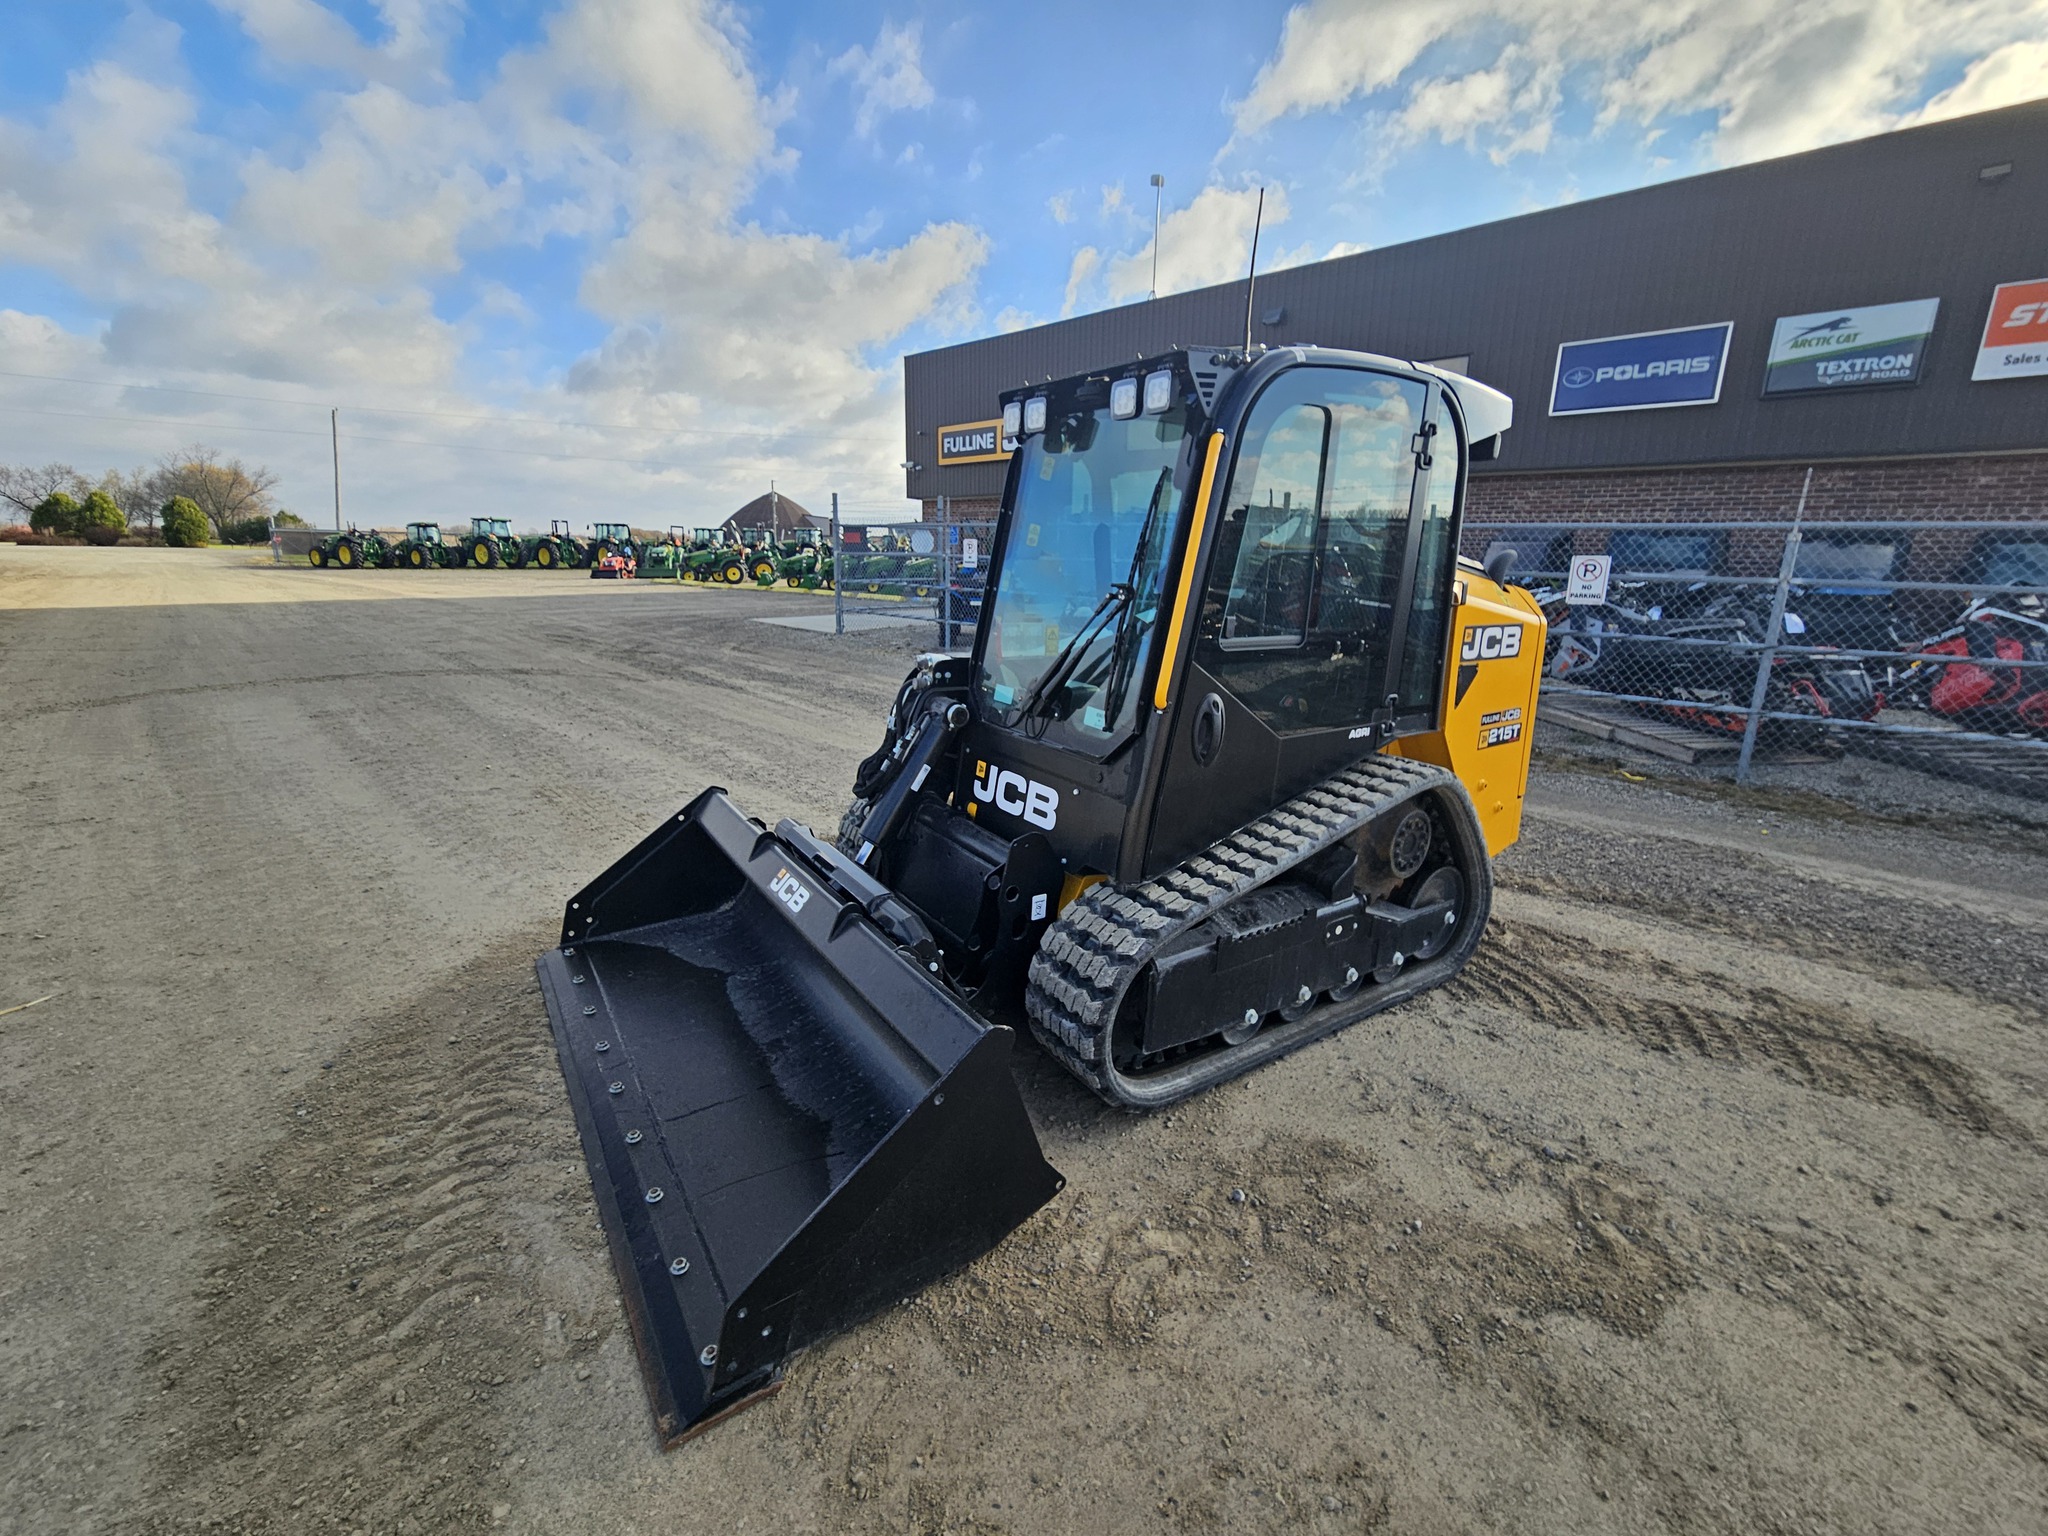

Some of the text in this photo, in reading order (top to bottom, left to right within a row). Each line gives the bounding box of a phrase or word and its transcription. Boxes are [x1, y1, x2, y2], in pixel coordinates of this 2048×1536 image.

[1790, 332, 1862, 350] ARCTIC CAT
[1595, 355, 1711, 383] POLARIS
[1815, 353, 1914, 376] TEXTRON
[2003, 353, 2041, 366] Sales
[1843, 368, 1911, 382] OFF ROAD
[943, 432, 995, 453] FULLINE
[1462, 626, 1522, 660] JCB
[1500, 708, 1521, 722] JCB
[1348, 726, 1371, 740] AGRI
[1488, 723, 1521, 744] 215T
[973, 764, 1059, 831] JCB
[770, 872, 810, 913] JCB
